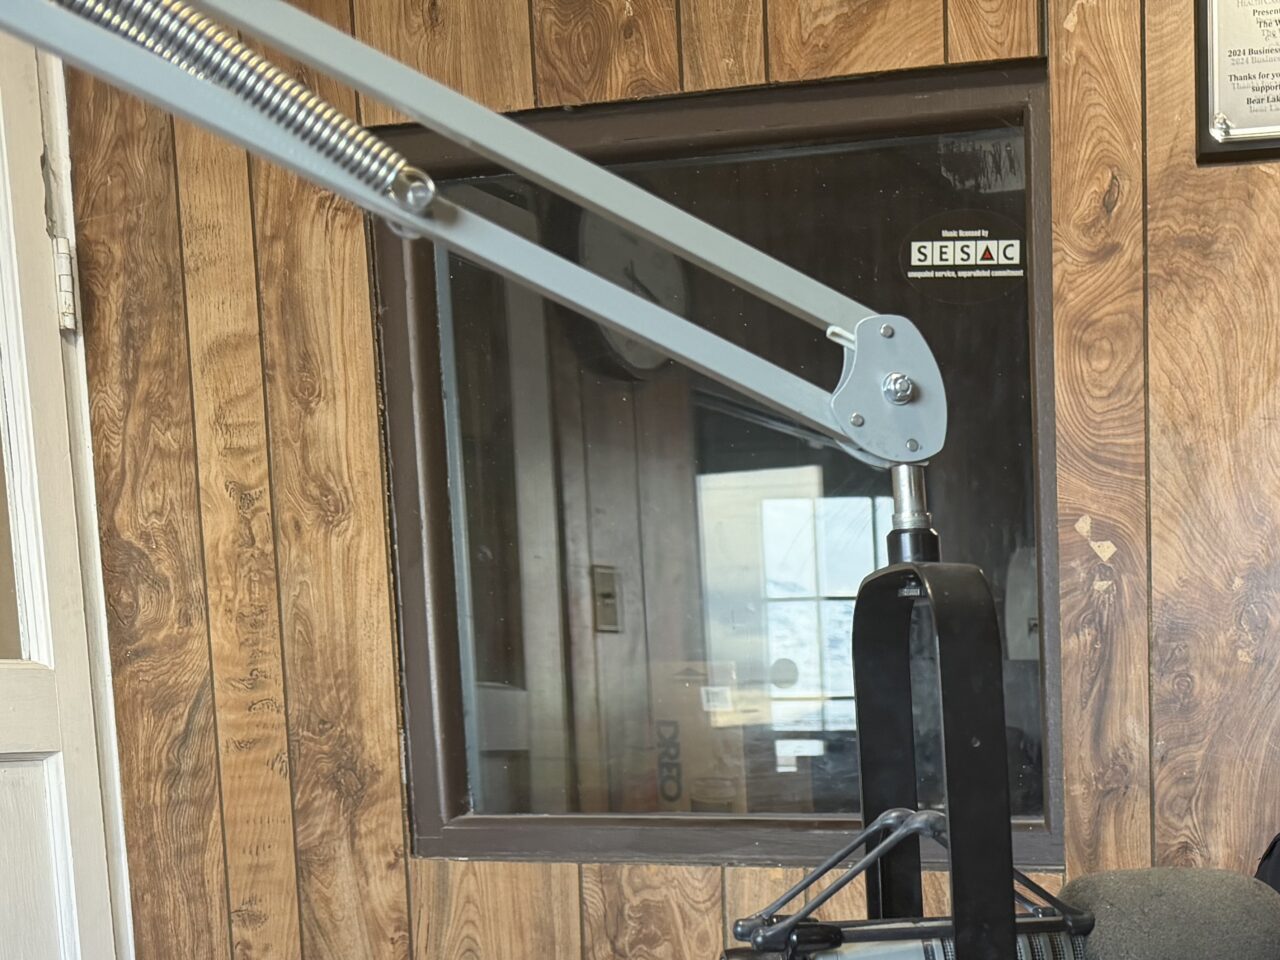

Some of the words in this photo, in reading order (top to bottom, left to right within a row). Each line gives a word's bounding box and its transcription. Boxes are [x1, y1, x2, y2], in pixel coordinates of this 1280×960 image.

[1258, 19, 1273, 28] The
[1228, 49, 1246, 58] 2024
[1228, 73, 1256, 82] Thanks
[1258, 71, 1270, 80] for
[1246, 96, 1266, 106] Bear
